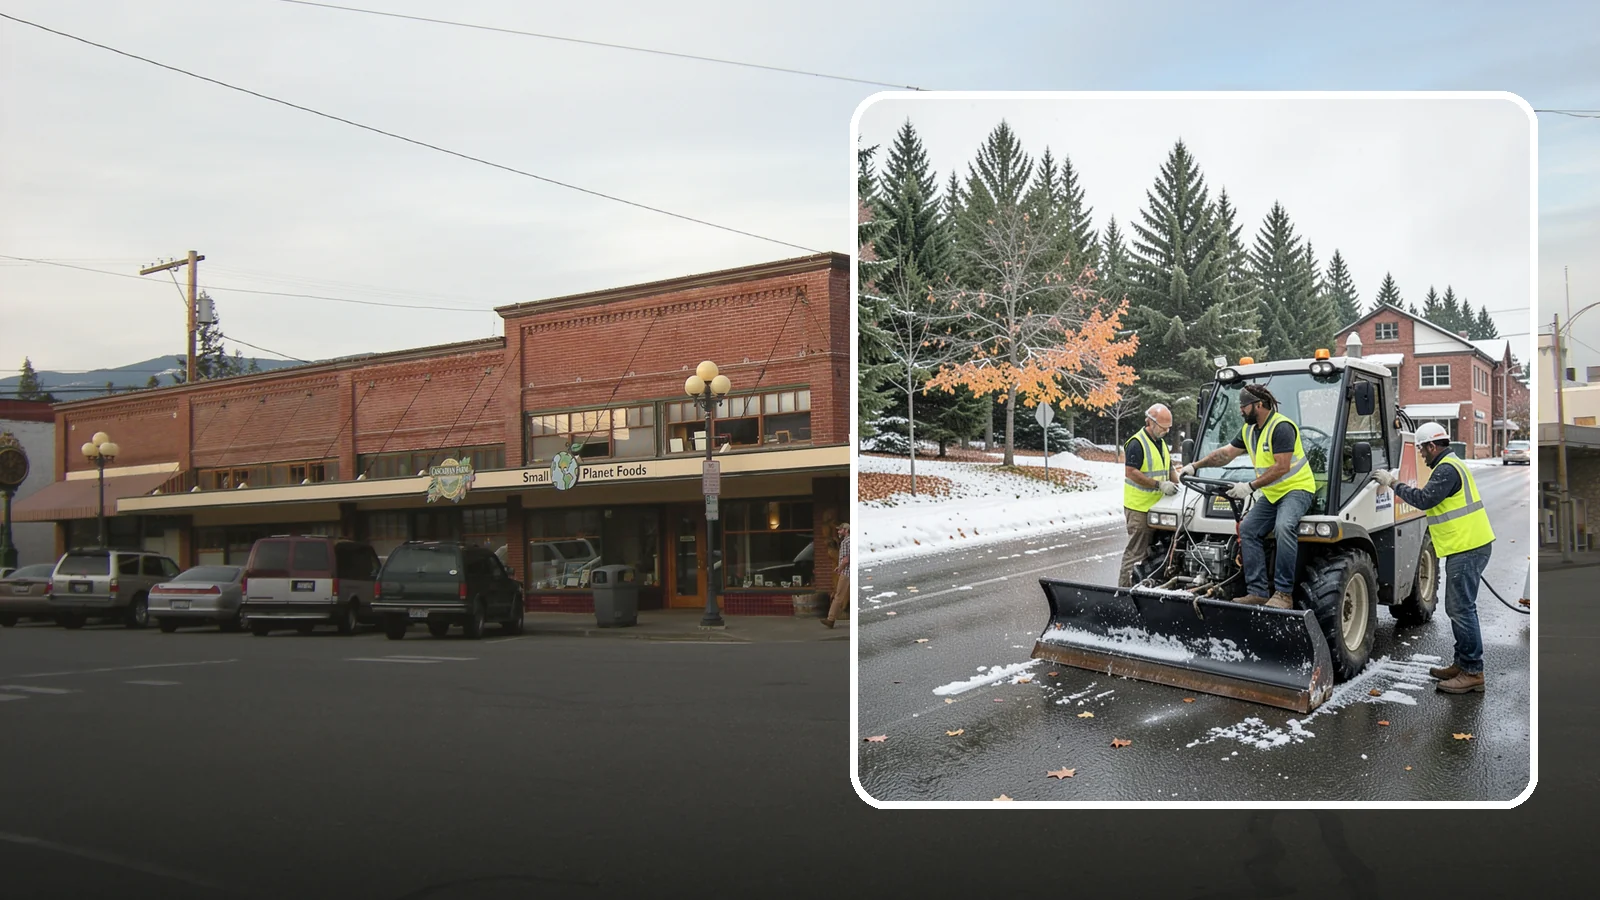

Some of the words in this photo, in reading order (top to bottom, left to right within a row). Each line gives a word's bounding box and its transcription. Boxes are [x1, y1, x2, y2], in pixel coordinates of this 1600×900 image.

[523, 471, 549, 482] Small
[583, 467, 614, 479] Planet
[617, 464, 647, 476] Foods
